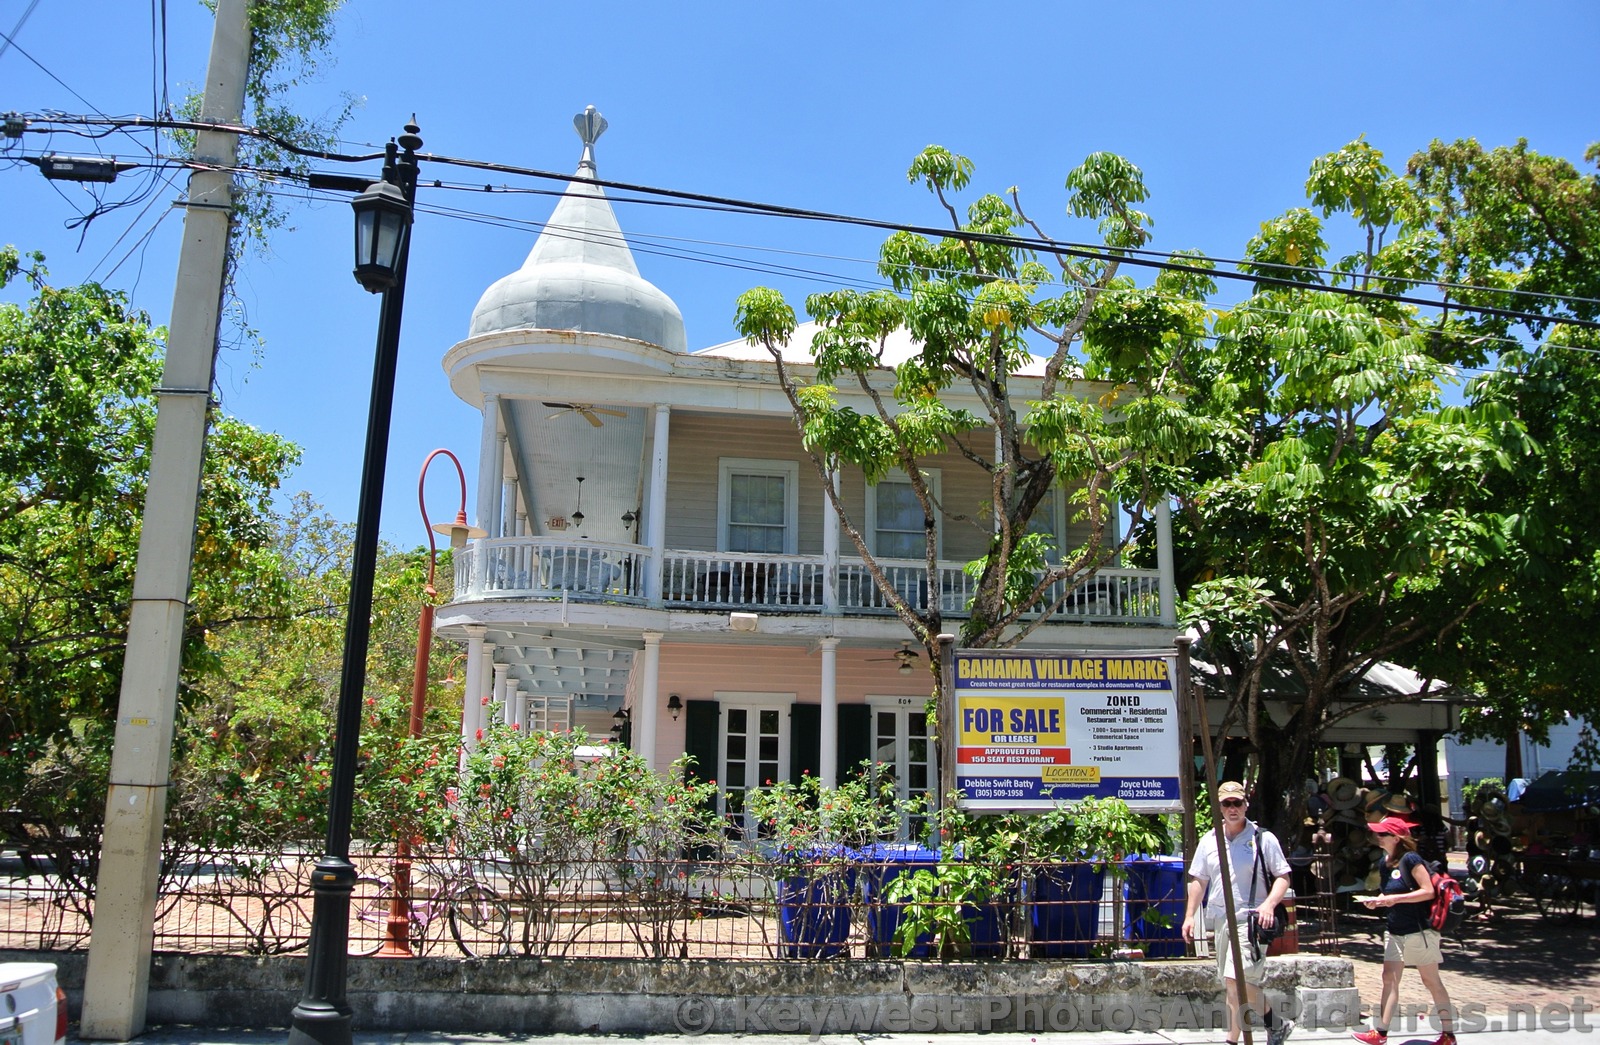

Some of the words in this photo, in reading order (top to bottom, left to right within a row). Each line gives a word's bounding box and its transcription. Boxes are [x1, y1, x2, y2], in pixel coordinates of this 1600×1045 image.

[958, 658, 1034, 680] BAHAMA
[1035, 659, 1104, 680] VILLAGE
[1011, 681, 1026, 689] great
[1076, 682, 1099, 690] complex
[1134, 682, 1145, 690] Key
[1145, 682, 1162, 690] West!
[1106, 695, 1141, 707] ZONED
[1080, 707, 1122, 716] Commercial
[1129, 707, 1168, 716] Residential
[963, 708, 1004, 733] FOR
[1009, 708, 1060, 733] SALE
[994, 735, 1008, 743] OR
[1008, 735, 1034, 743] LEASE
[1123, 733, 1140, 741] Space
[1114, 744, 1144, 752] Apartments
[1089, 767, 1096, 777] 3
[964, 779, 992, 788] Debbie
[992, 779, 1013, 788] Swift
[1013, 780, 1034, 790] Batty
[1120, 780, 1142, 790] Joyce
[1142, 780, 1162, 788] Unke
[975, 789, 993, 798] (305)
[993, 789, 1024, 797] 509-1958
[1117, 789, 1136, 798] (305)
[1135, 789, 1165, 797] 292-8982
